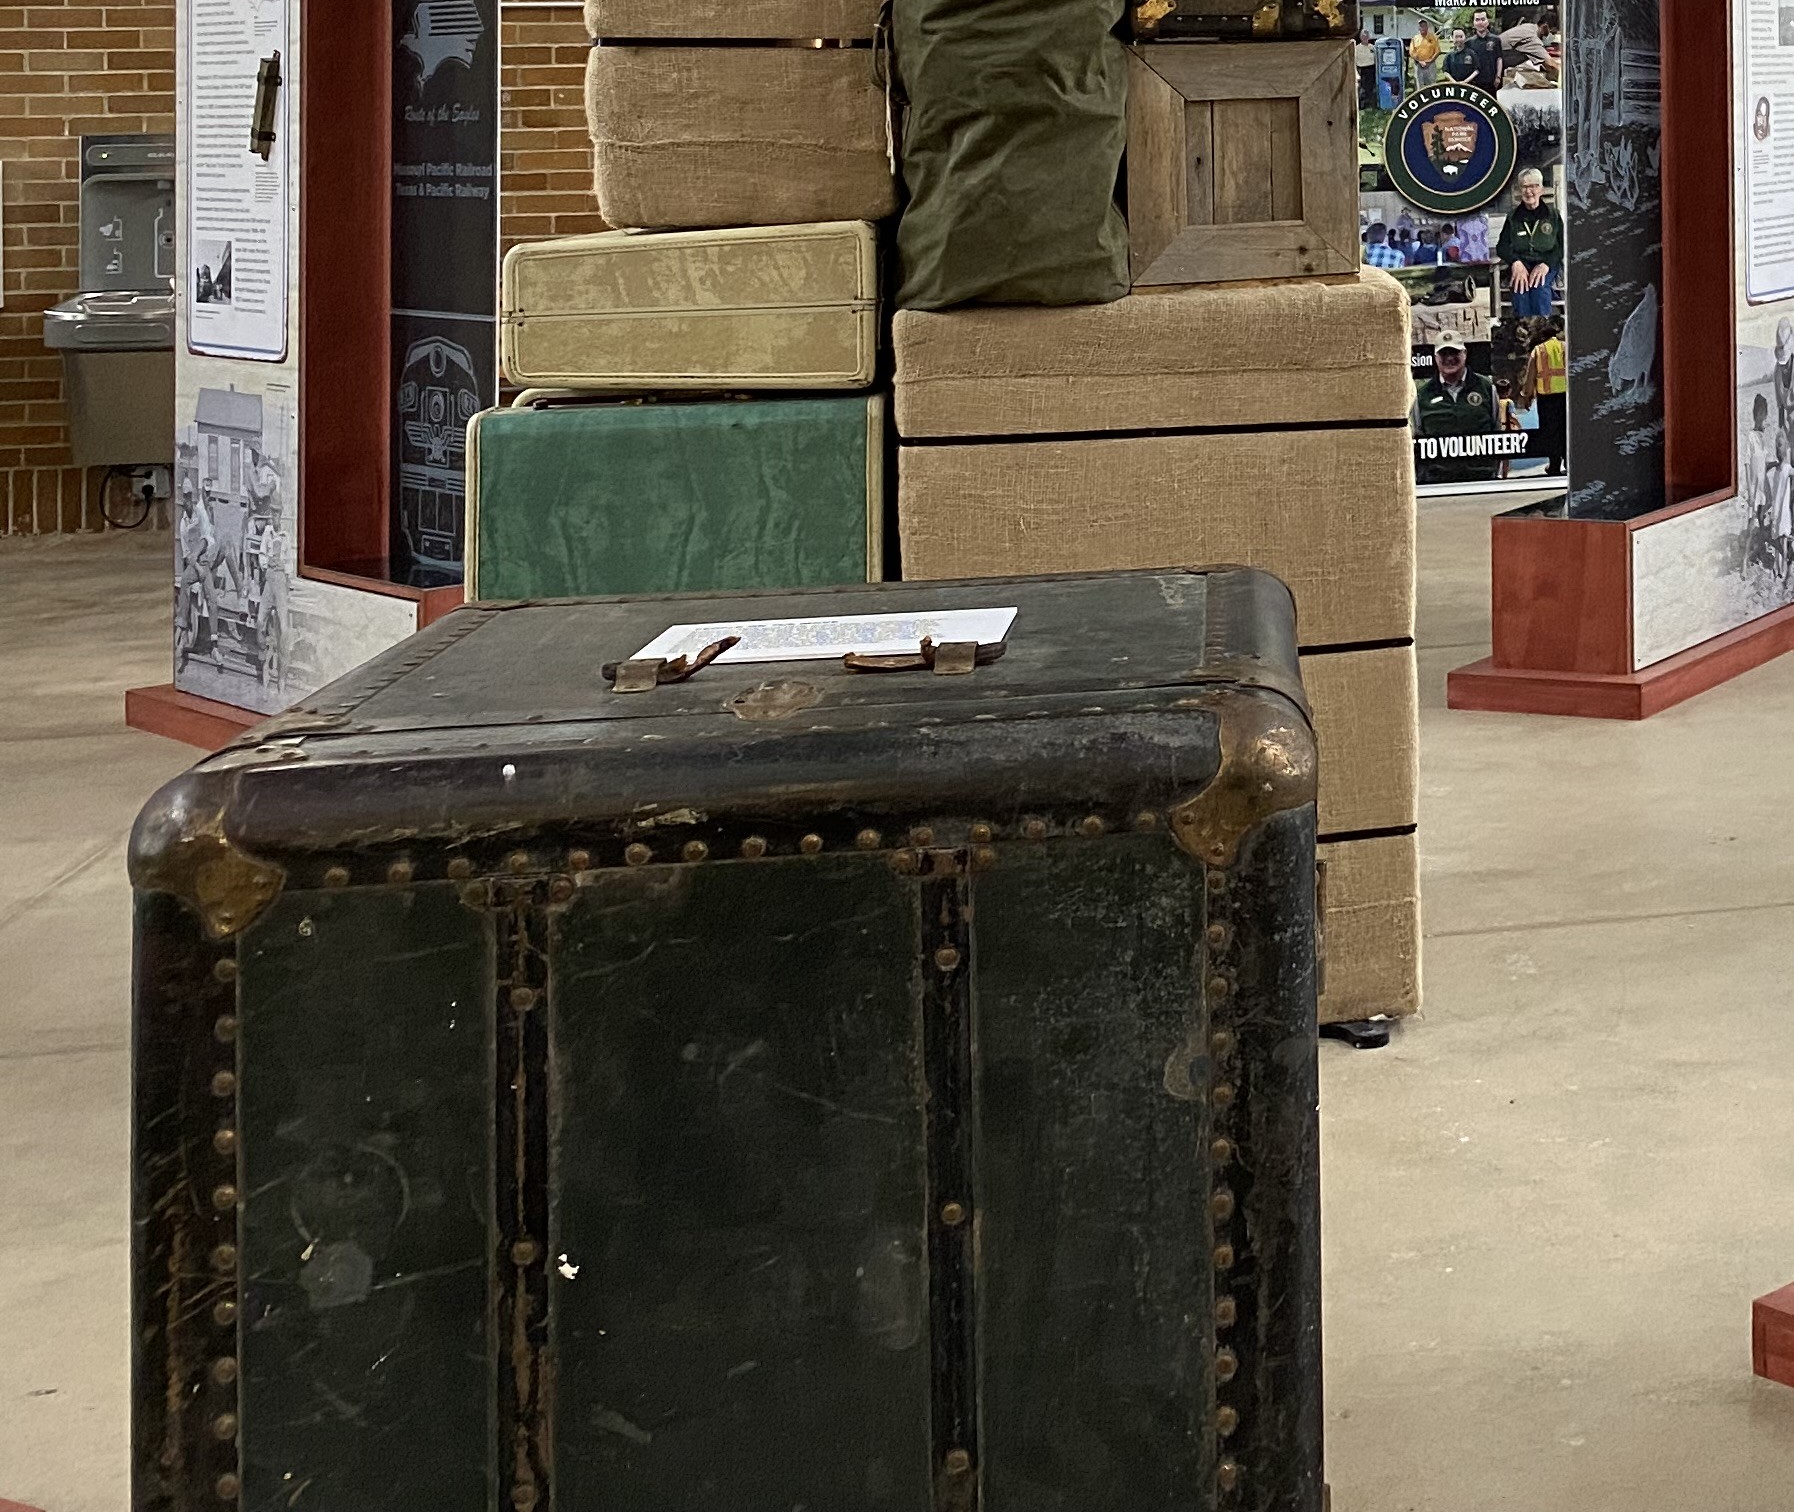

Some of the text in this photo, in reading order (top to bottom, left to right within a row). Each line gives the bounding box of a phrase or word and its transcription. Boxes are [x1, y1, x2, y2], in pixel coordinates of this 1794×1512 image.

[1398, 87, 1499, 119] VOLUNTEER
[1418, 437, 1438, 459] TO
[1440, 433, 1529, 458] VOLUNTEER?
